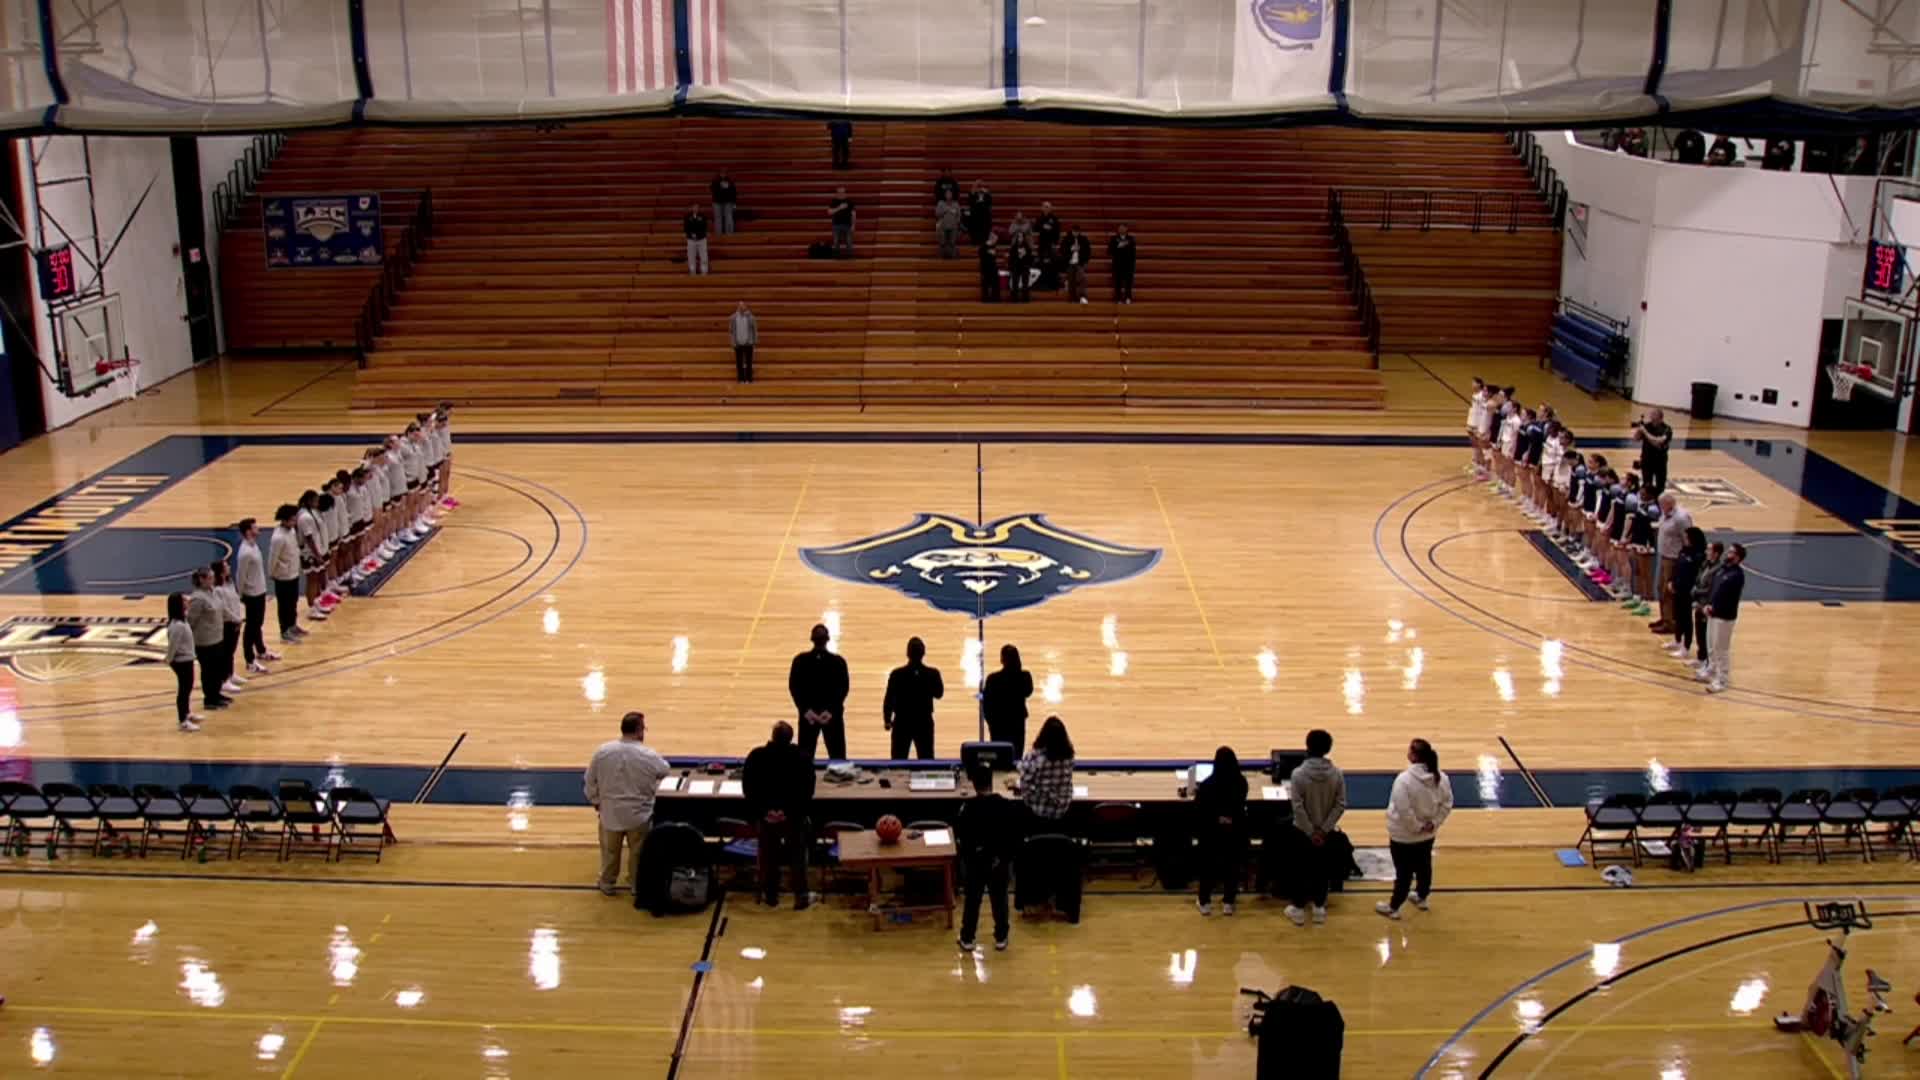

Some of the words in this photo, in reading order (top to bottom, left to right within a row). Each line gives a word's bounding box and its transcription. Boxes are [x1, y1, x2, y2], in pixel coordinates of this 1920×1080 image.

[296, 207, 345, 222] LEC
[0, 475, 170, 574] RTMOUTH
[0, 624, 169, 646] LE
